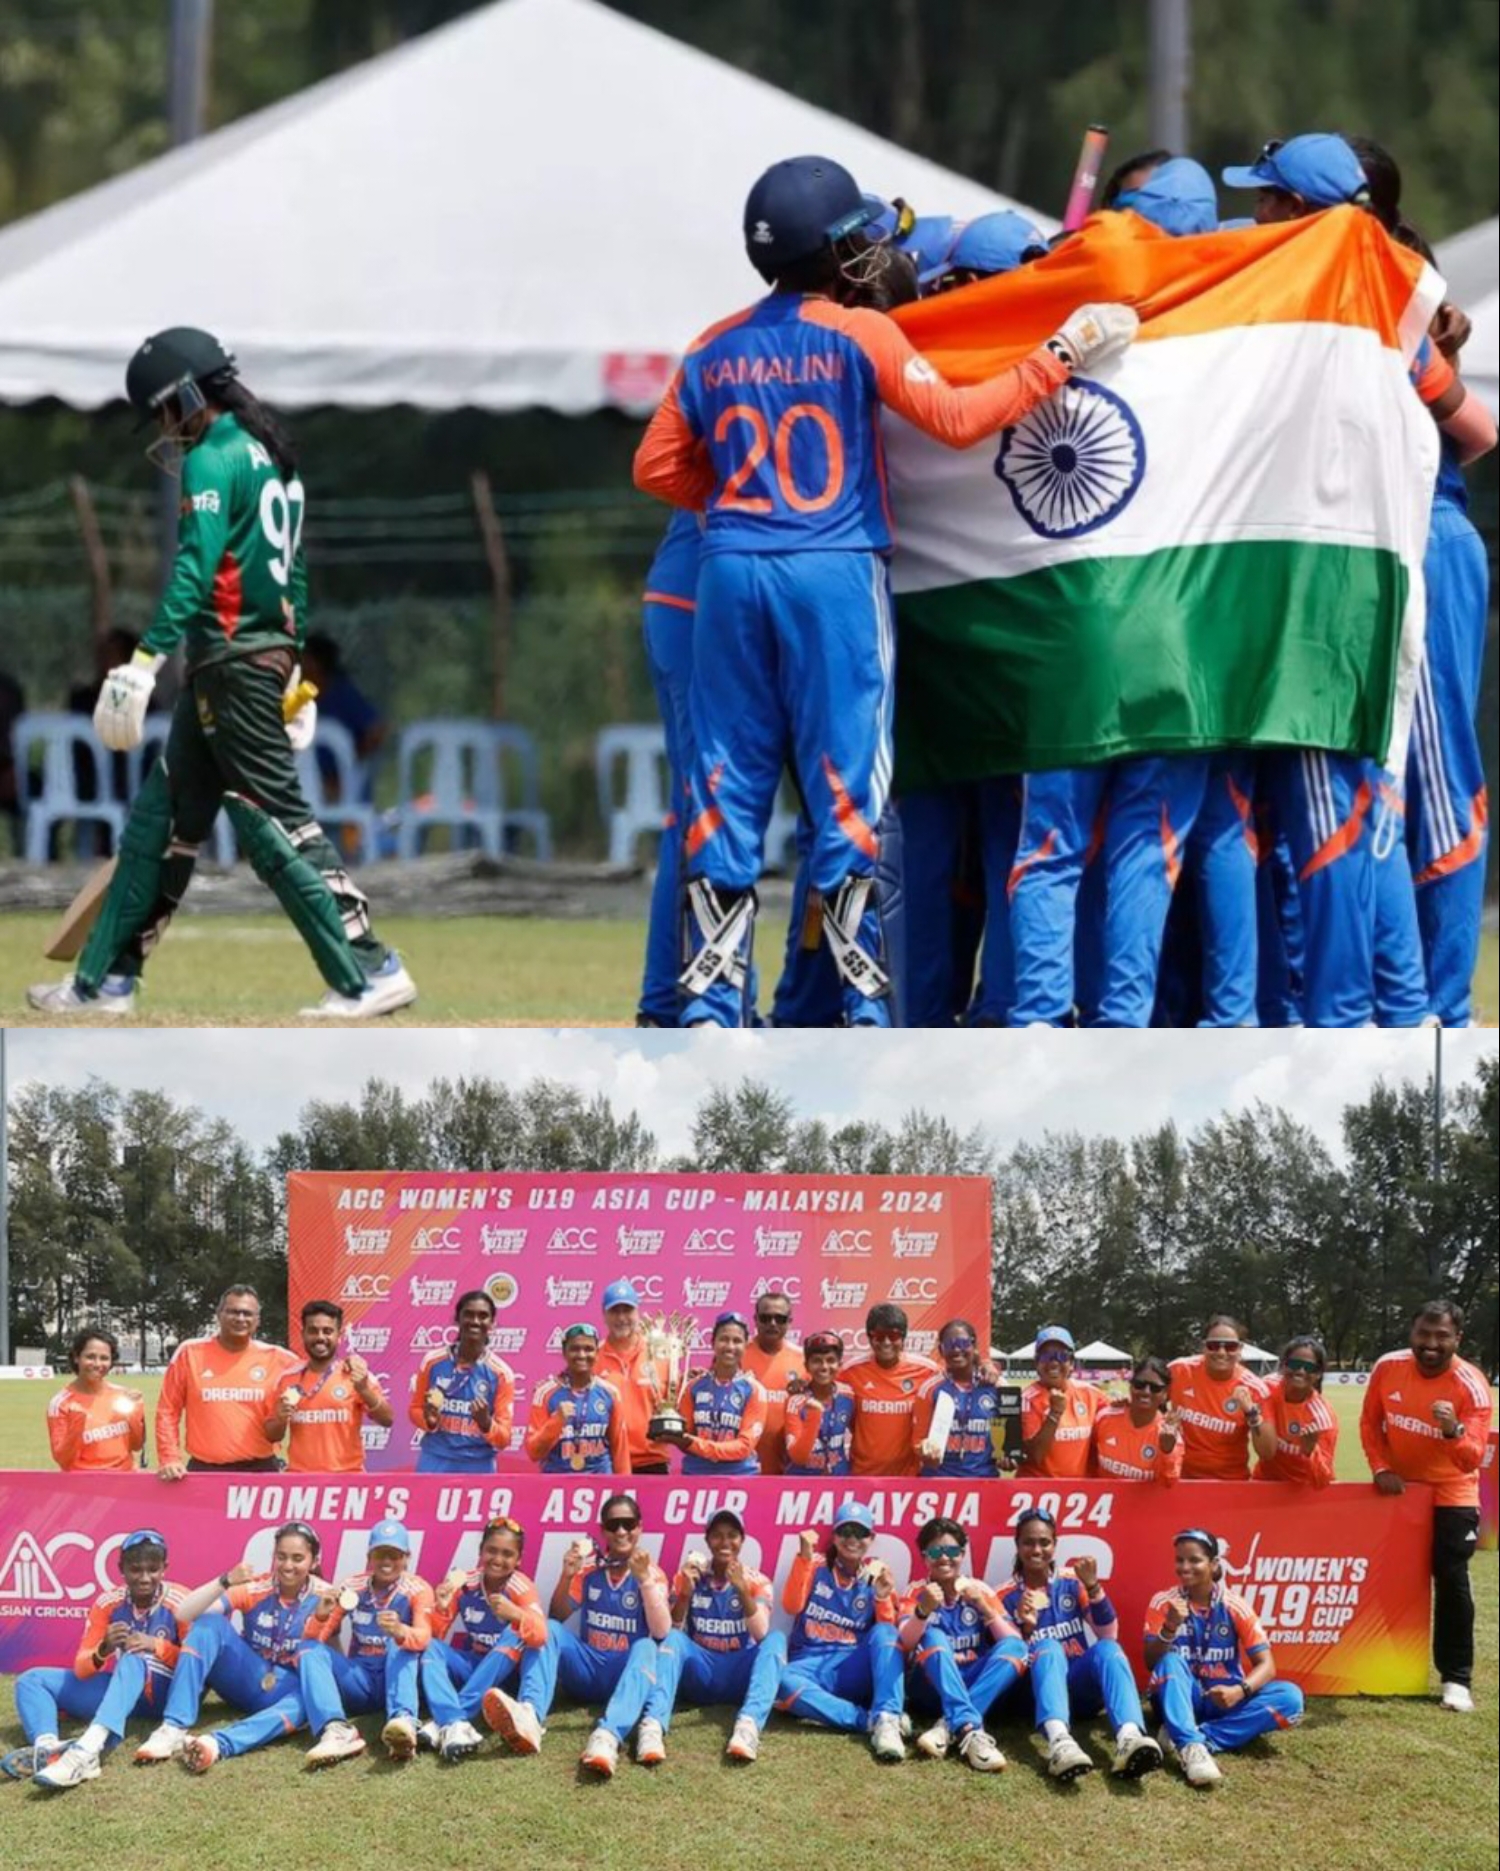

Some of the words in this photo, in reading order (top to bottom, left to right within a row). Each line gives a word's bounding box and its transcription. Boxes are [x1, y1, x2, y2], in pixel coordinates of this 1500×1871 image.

[702, 353, 845, 389] KAMALINI
[714, 404, 845, 514] 20
[697, 949, 723, 978] SS
[843, 950, 869, 978] SS
[337, 1189, 386, 1210] ACC
[400, 1188, 513, 1210] WOMEN'S
[528, 1189, 575, 1210] U19
[591, 1189, 650, 1211] ASIA
[665, 1190, 716, 1211] CUP
[743, 1191, 864, 1212] MALAYSIA
[880, 1191, 944, 1213] 2024
[410, 1228, 461, 1249] ACC
[547, 1228, 598, 1249] ACC
[683, 1229, 734, 1250] ACC
[820, 1230, 871, 1251] ACC
[340, 1275, 391, 1296] ACC
[886, 1278, 937, 1299] ACC
[226, 1485, 409, 1521] WOMEN'S
[436, 1488, 513, 1522] U19
[1255, 1557, 1369, 1583] WOMEN'S
[1311, 1585, 1359, 1605] ASIA
[0, 1606, 31, 1616] SIAN
[35, 1606, 89, 1618] CRICKET
[1312, 1607, 1354, 1628] CUP
[1307, 1630, 1340, 1643] 2024
